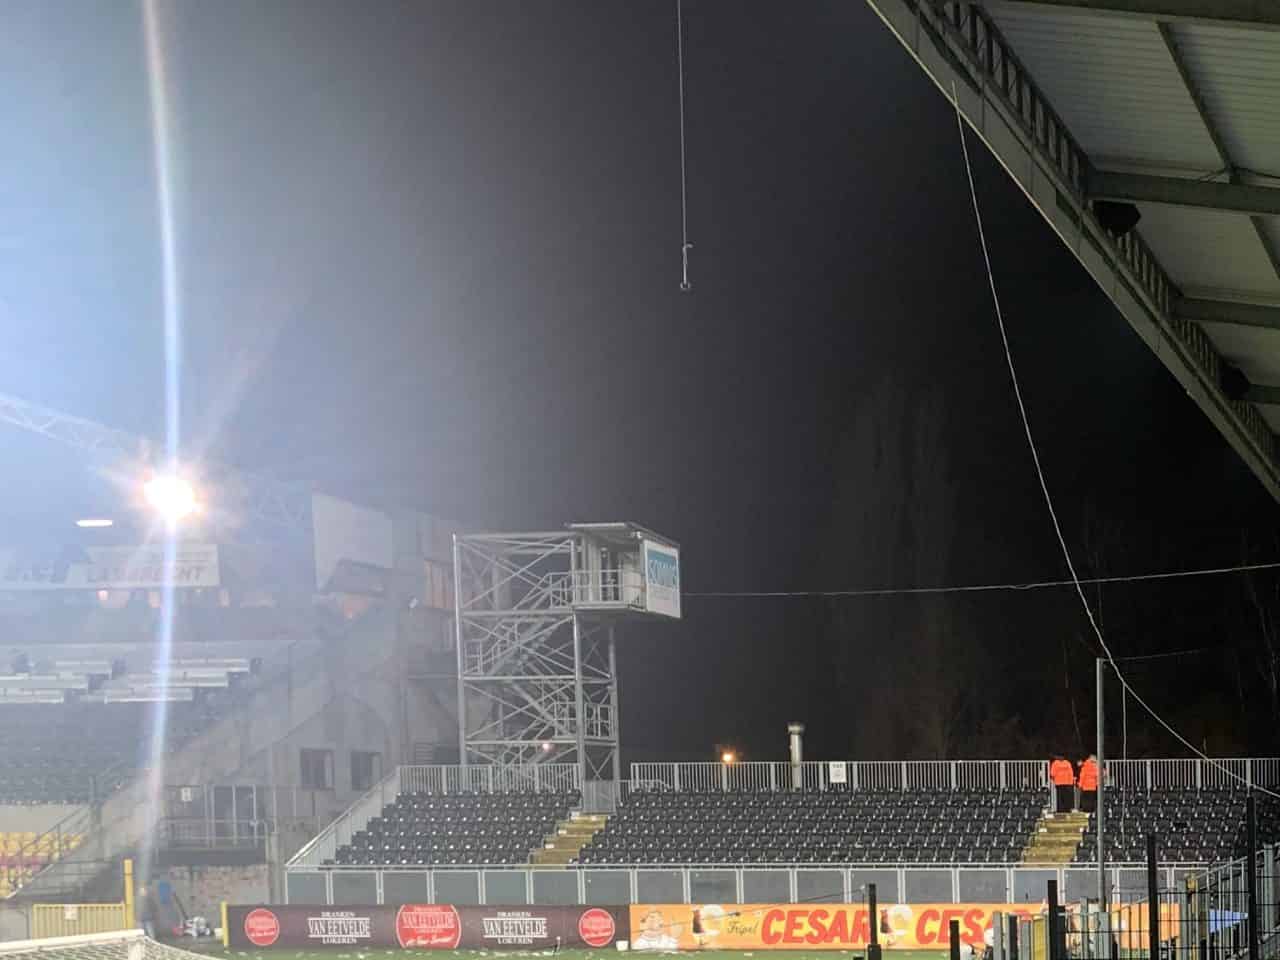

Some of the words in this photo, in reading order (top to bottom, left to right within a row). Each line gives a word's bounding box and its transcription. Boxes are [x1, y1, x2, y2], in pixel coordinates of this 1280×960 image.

[308, 919, 326, 935] VAN
[327, 919, 370, 935] EETVELDE
[483, 919, 502, 935] VAN
[503, 919, 546, 935] EETVELDE
[761, 909, 871, 945] CESAR
